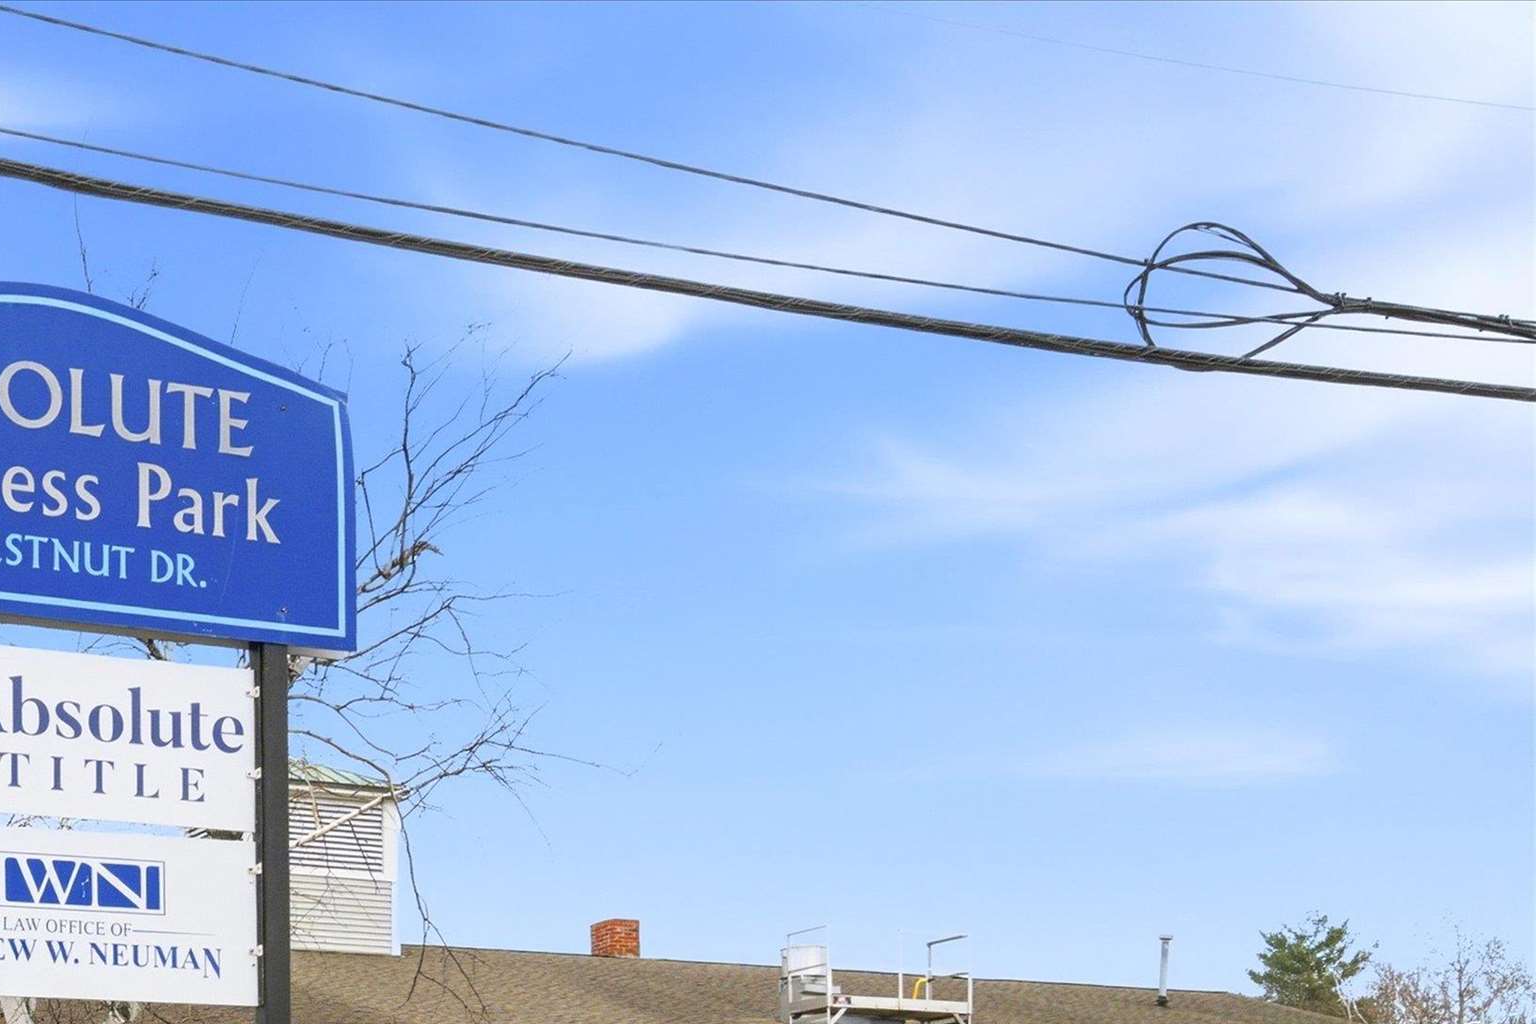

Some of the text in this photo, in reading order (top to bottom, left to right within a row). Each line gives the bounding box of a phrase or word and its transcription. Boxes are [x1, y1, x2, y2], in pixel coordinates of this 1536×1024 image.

[136, 462, 281, 545] Park
[150, 550, 208, 589] DR.
[3, 916, 42, 933] LAW
[46, 918, 108, 936] OFFICE
[111, 922, 133, 937] OF
[46, 940, 80, 965] W.
[90, 942, 223, 979] NEUMAN
